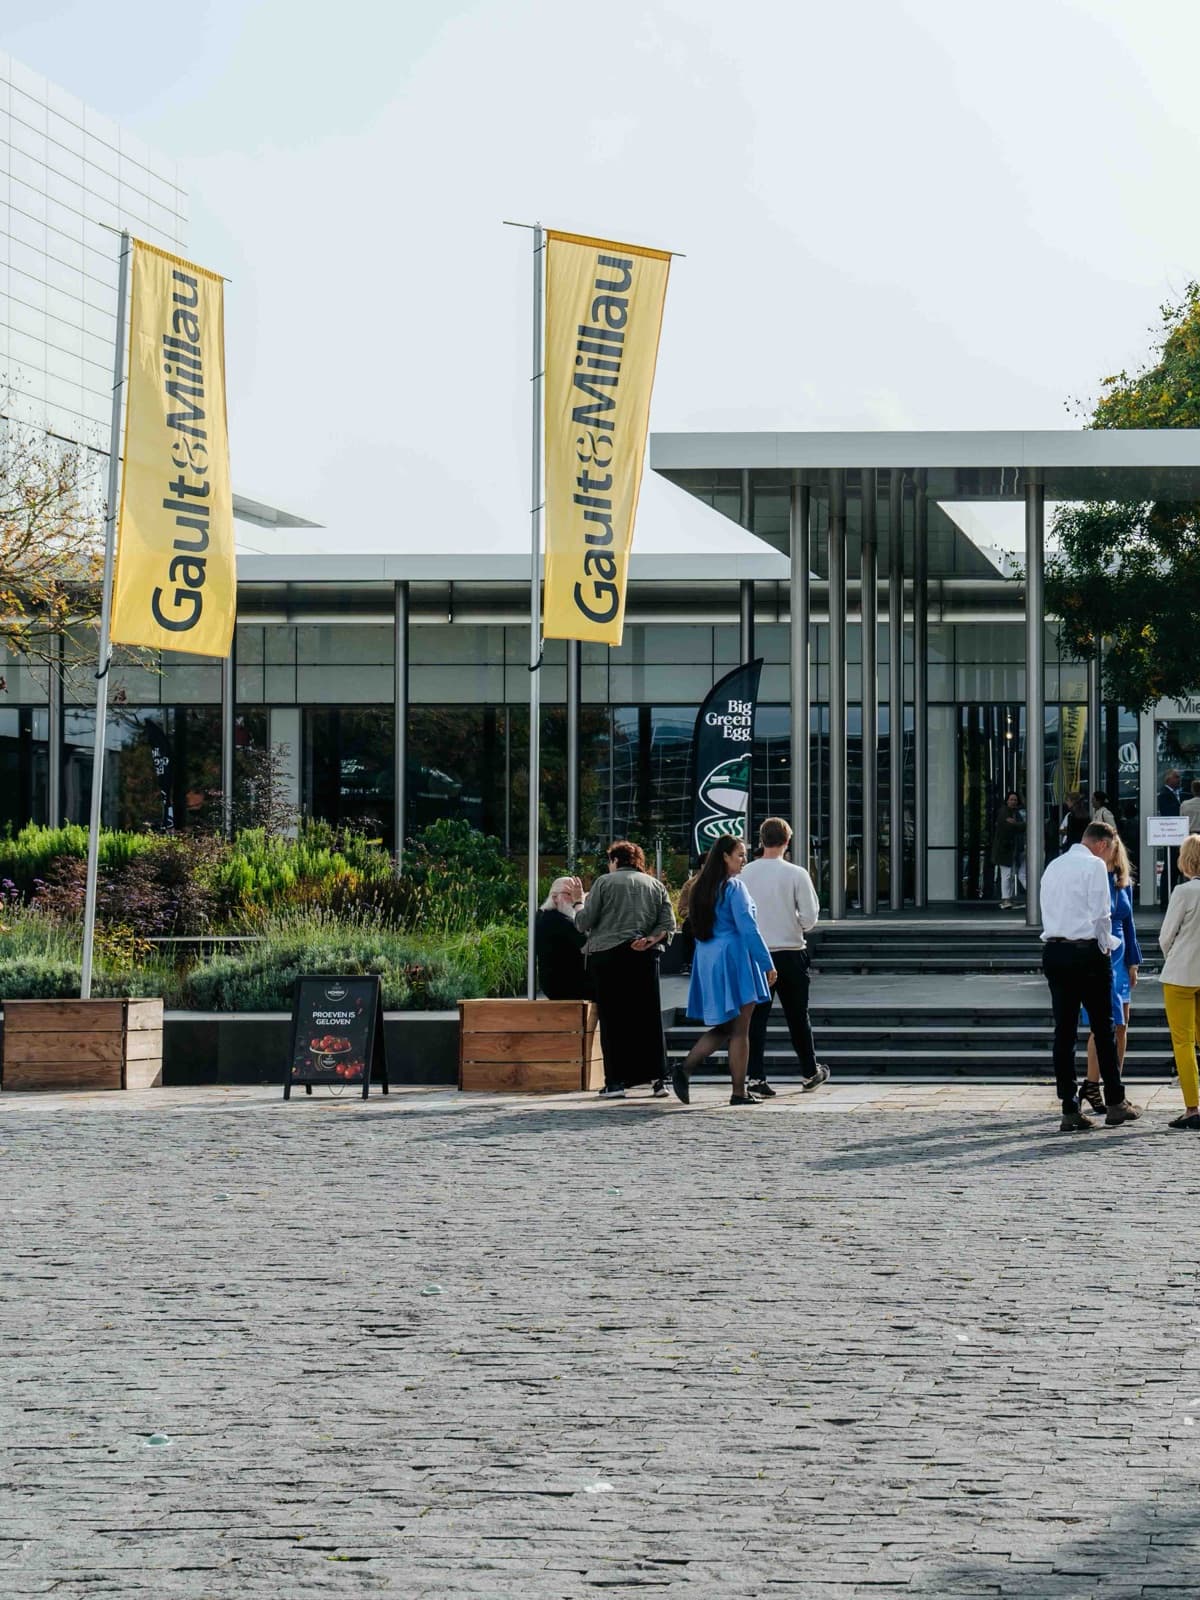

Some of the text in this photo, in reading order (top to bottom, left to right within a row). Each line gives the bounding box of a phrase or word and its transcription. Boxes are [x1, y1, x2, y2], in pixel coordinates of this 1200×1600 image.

[152, 270, 210, 632] Gault&Millau
[571, 255, 633, 624] Gault&Millau
[705, 712, 752, 726] Green
[728, 700, 752, 716] Big
